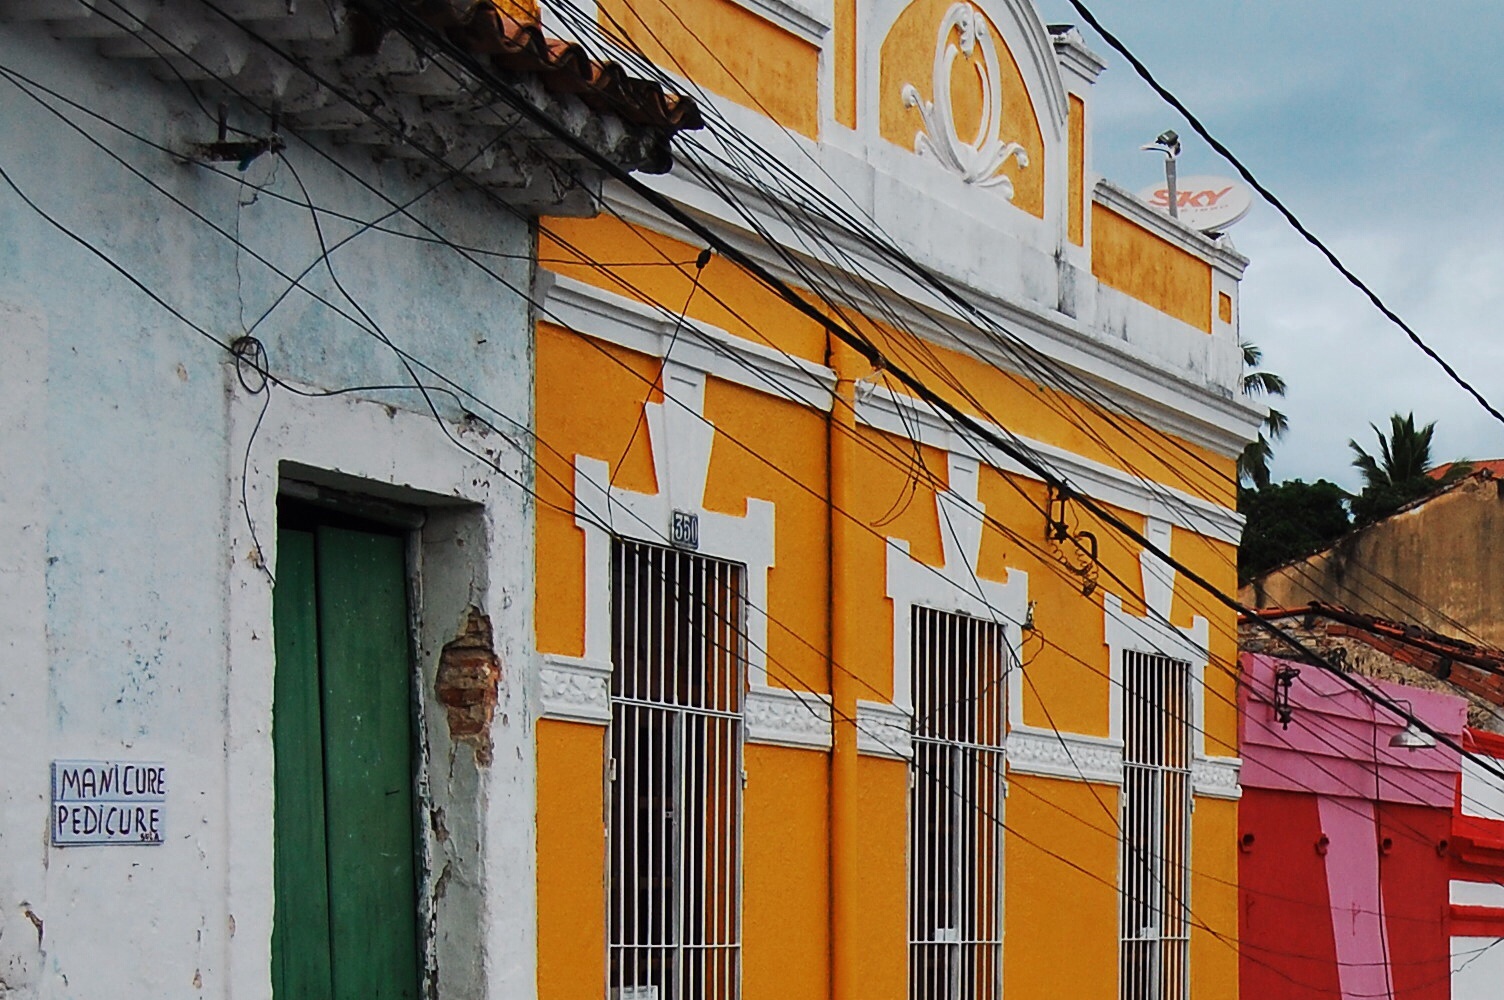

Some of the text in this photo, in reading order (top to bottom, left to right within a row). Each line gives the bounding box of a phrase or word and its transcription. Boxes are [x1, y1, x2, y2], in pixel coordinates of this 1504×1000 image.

[1149, 186, 1234, 207] SKY
[674, 512, 698, 544] 350
[61, 764, 165, 800] MANICURE
[58, 804, 160, 836] PEDICURE
